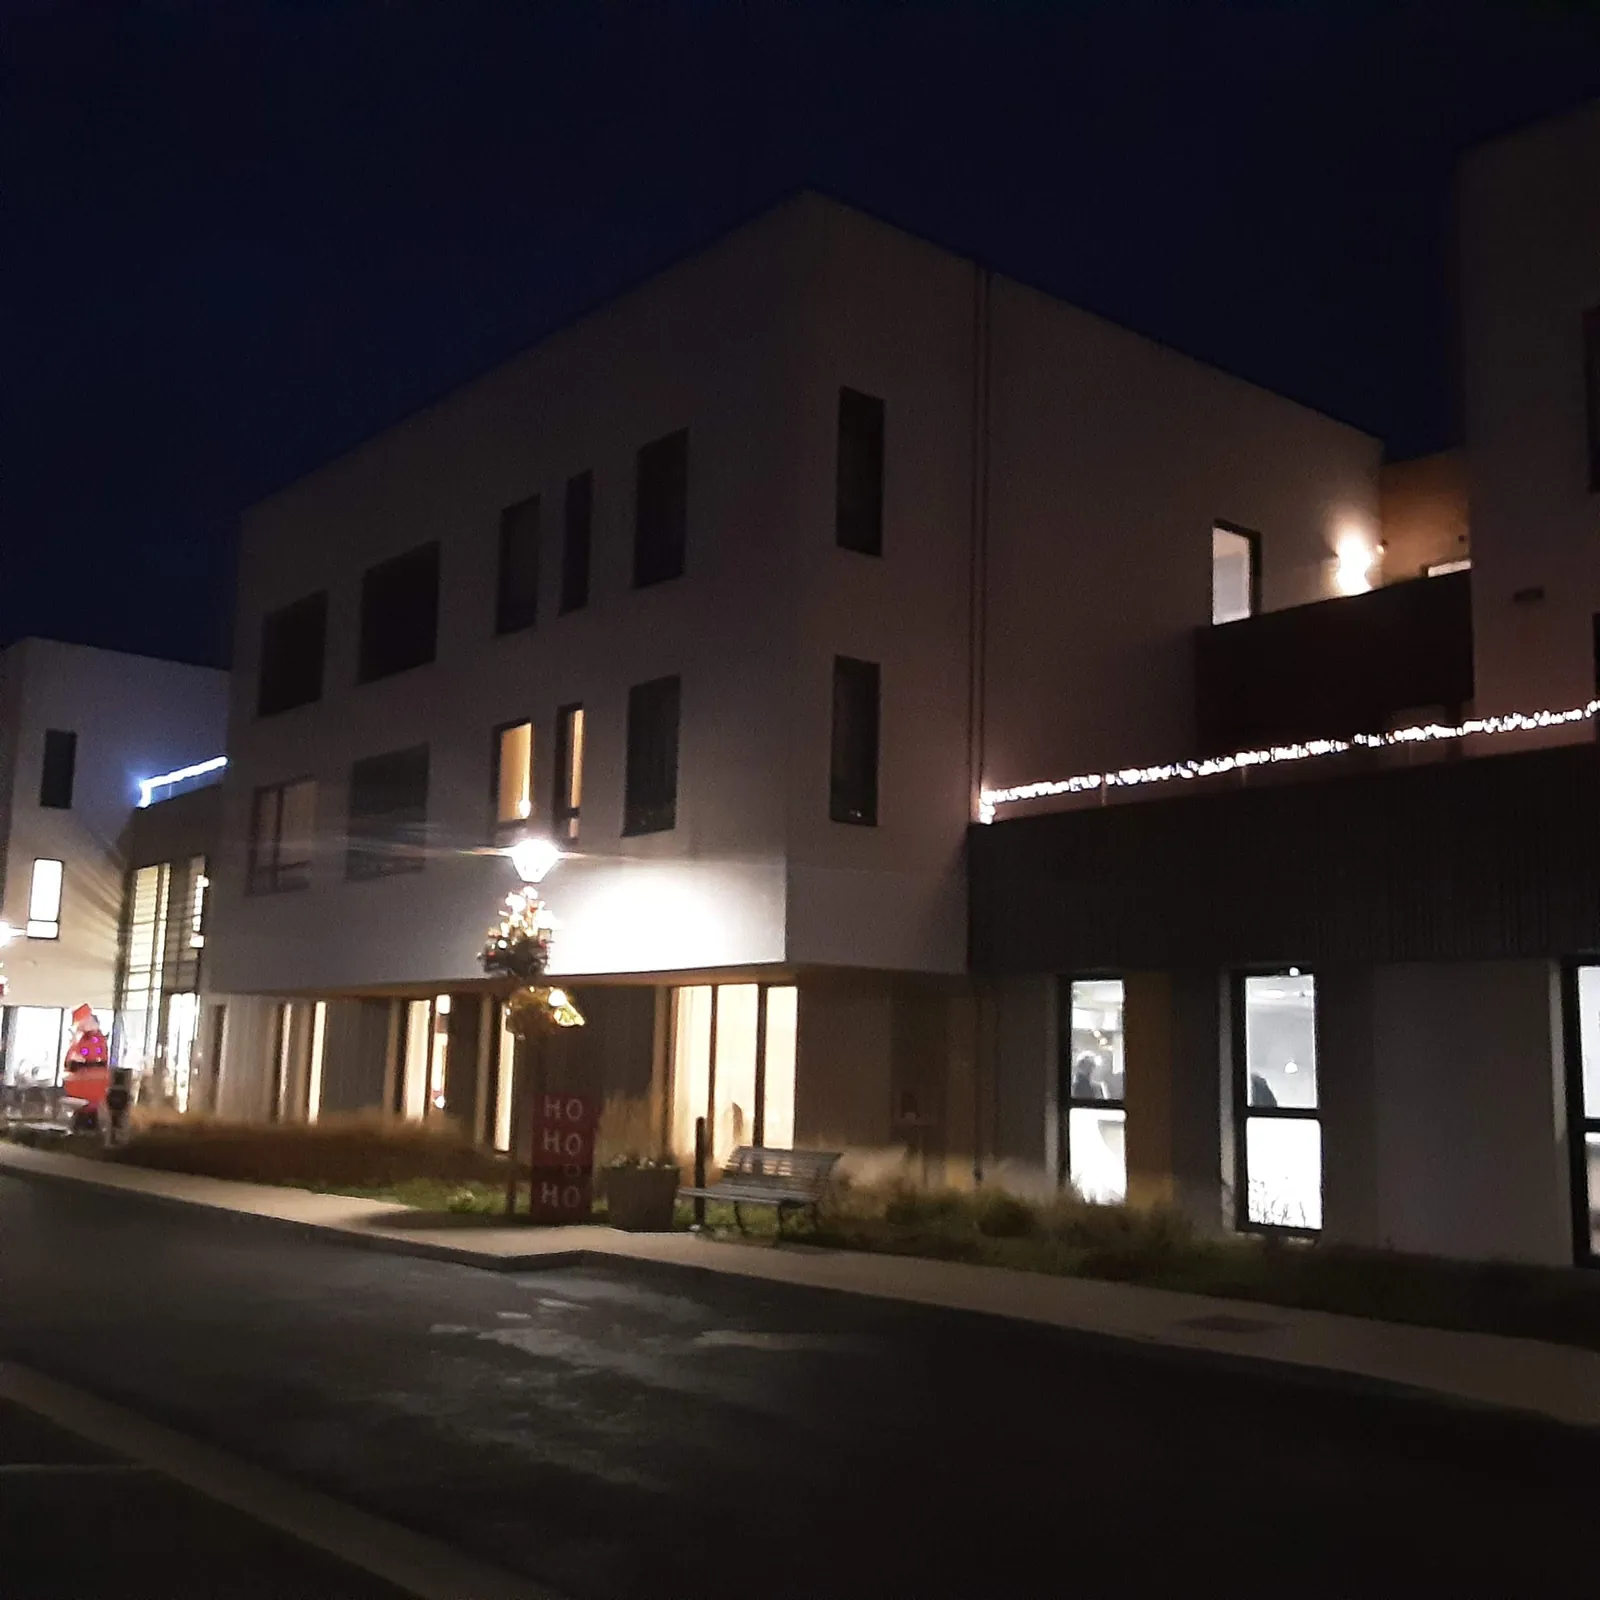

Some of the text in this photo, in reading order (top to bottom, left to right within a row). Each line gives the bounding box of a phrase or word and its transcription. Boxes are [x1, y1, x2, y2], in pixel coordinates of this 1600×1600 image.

[540, 1095, 583, 1121] HO
[542, 1128, 582, 1155] HO
[540, 1182, 580, 1208] HO
